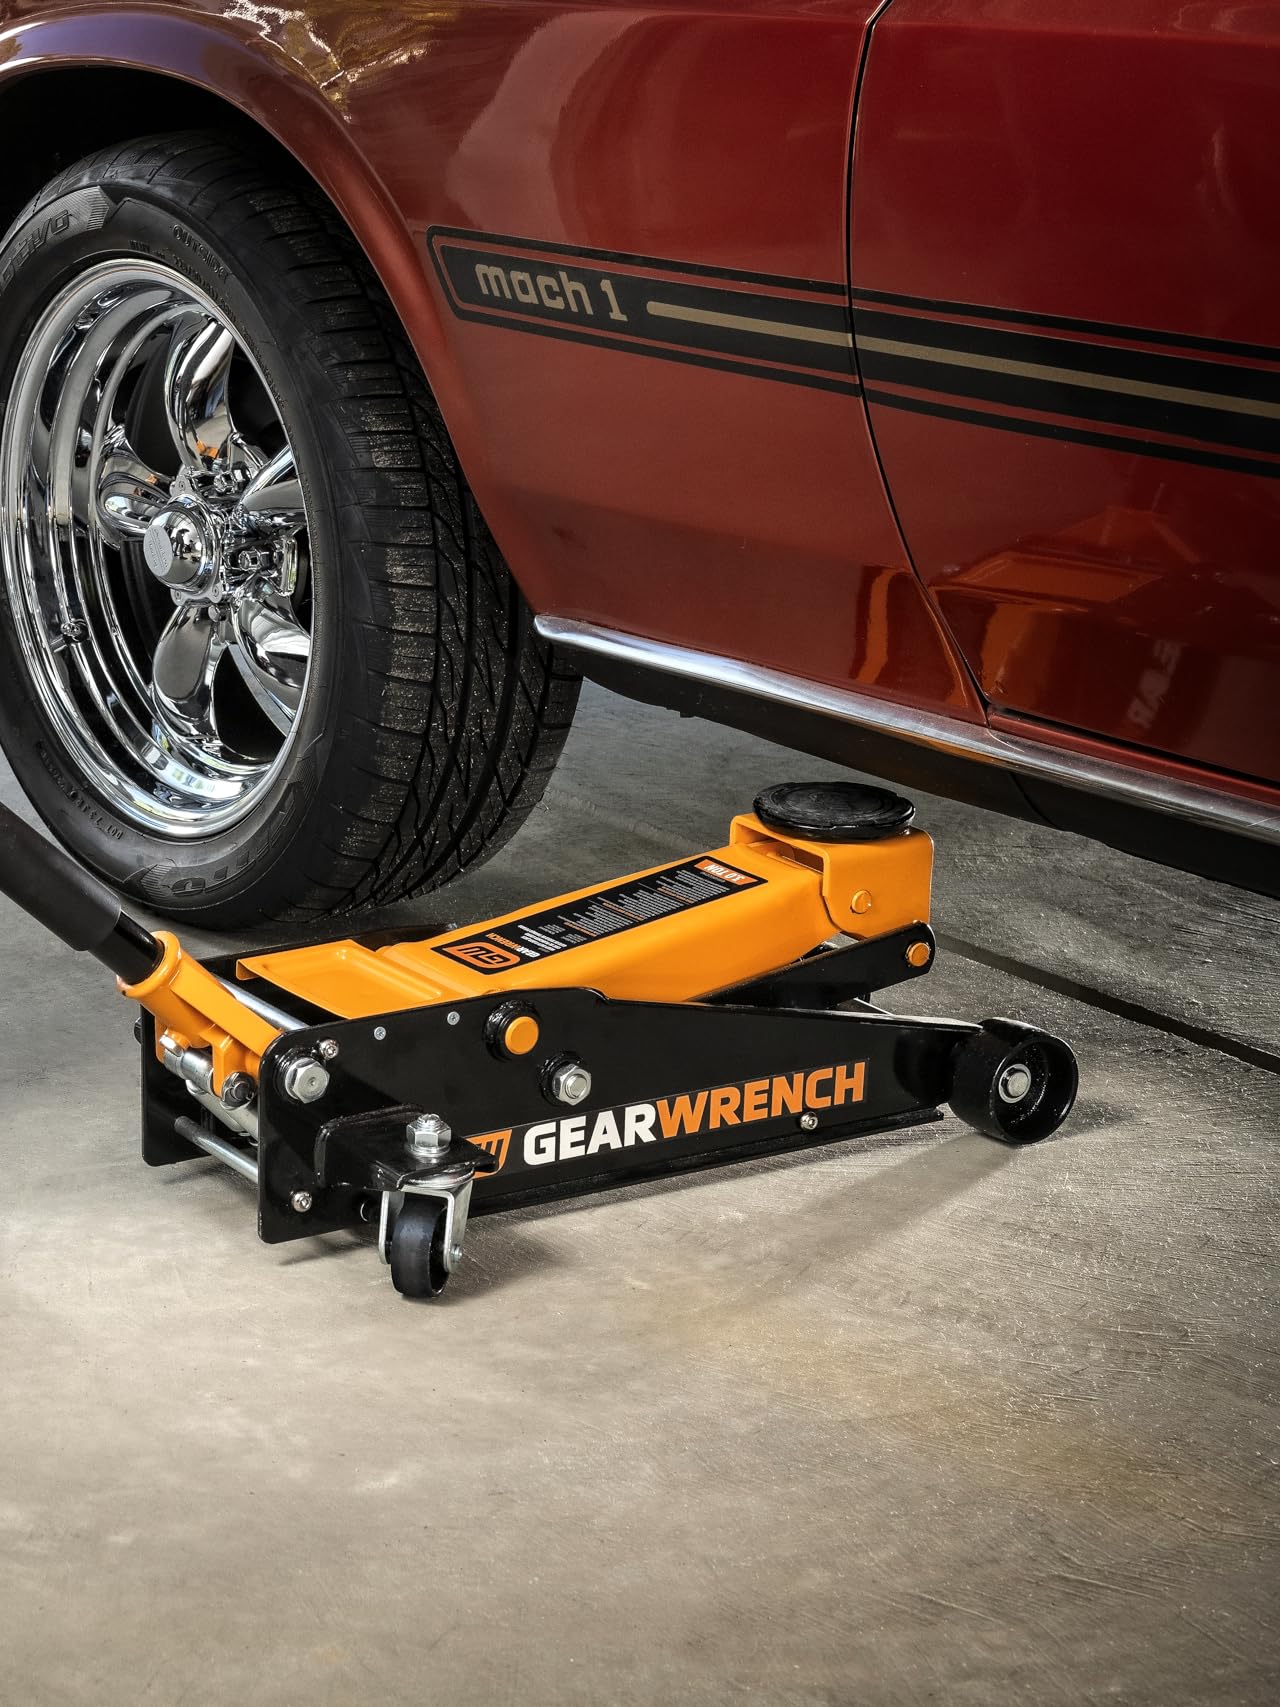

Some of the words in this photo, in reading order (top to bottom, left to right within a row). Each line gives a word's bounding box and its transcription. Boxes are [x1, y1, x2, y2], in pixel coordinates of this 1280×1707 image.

[475, 263, 593, 316] mach
[600, 279, 629, 322] 1
[704, 864, 729, 876] TON
[485, 932, 541, 958] GEARWRENCH
[523, 1061, 866, 1167] GEARWRENCH
